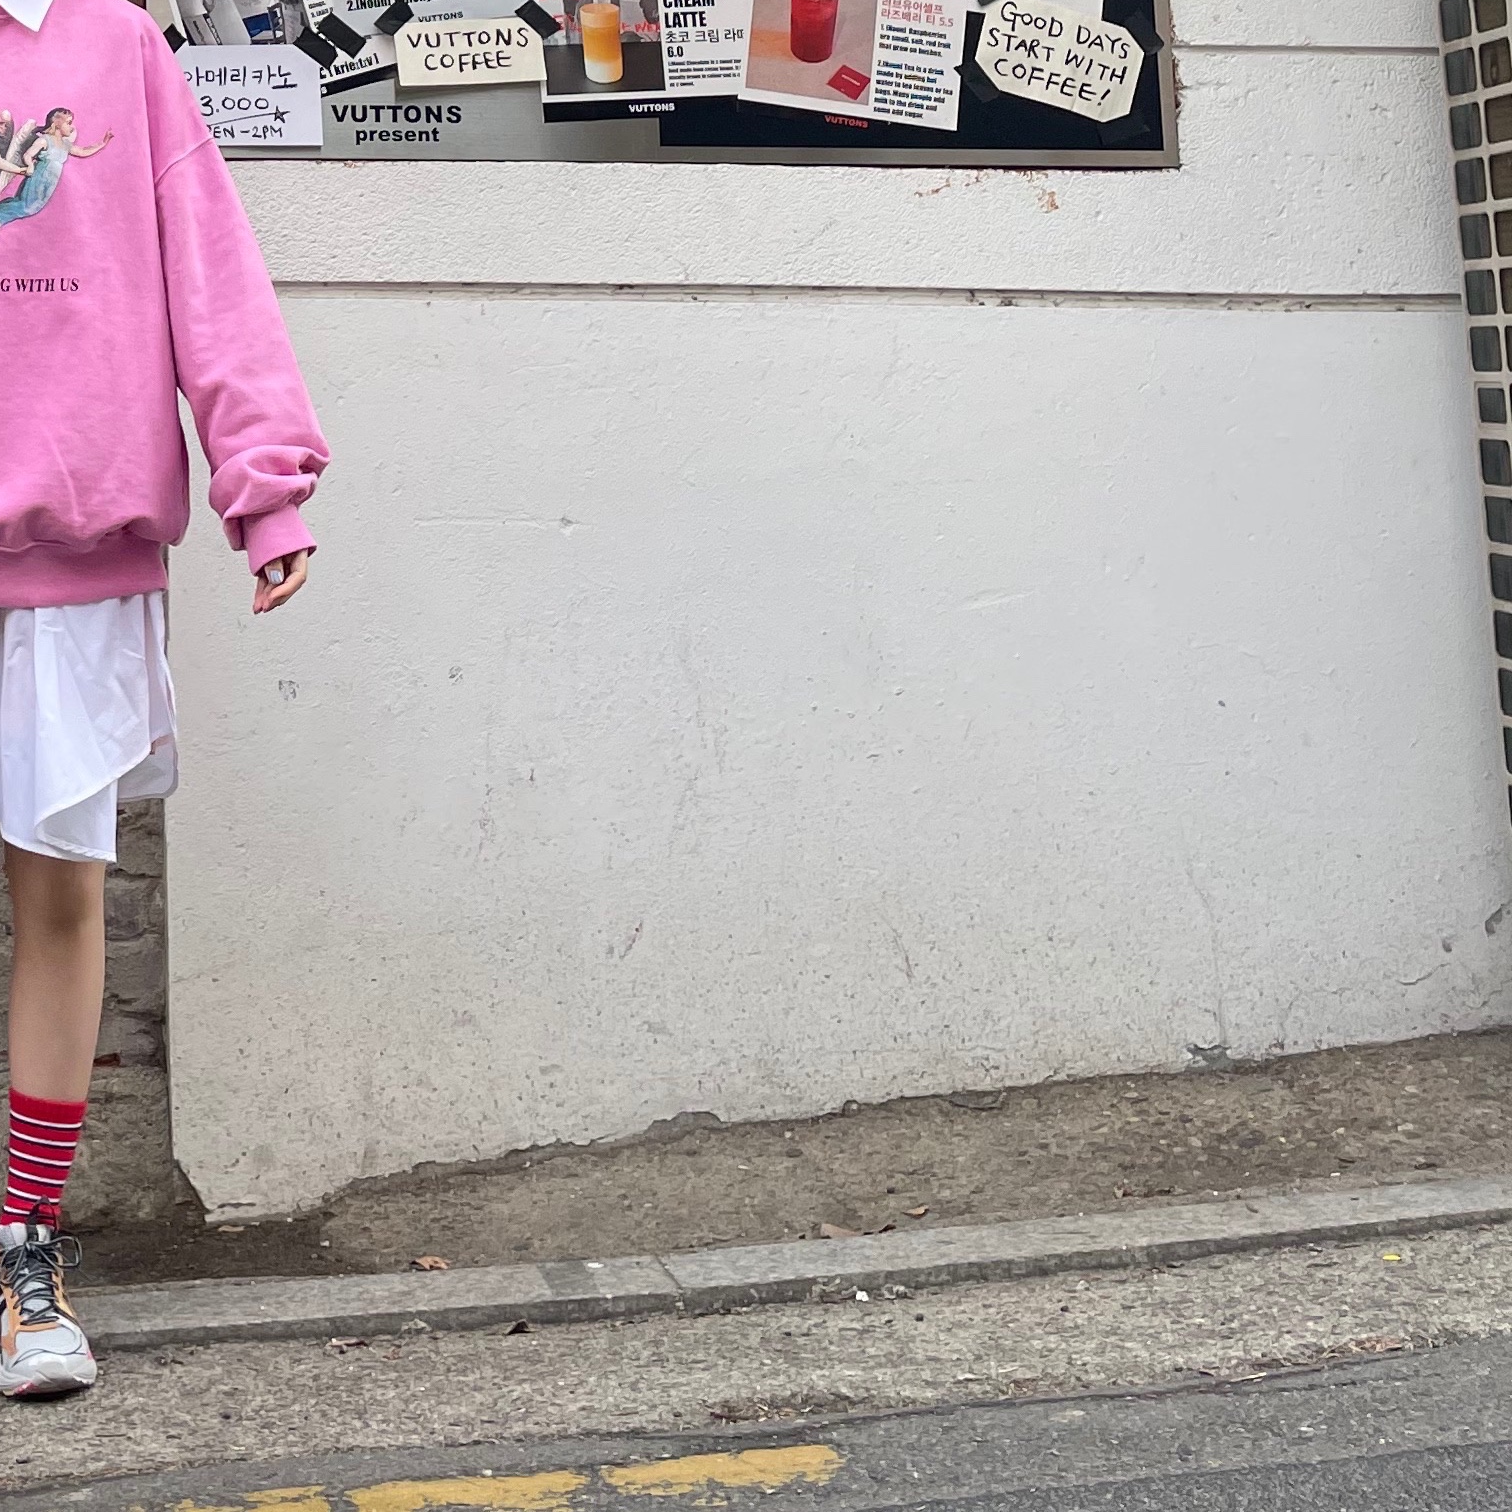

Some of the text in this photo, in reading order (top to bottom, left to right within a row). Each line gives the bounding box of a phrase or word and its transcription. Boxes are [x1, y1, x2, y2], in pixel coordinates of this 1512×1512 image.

[418, 12, 463, 22] VUTTONS
[664, 11, 707, 28] LATTE
[407, 27, 529, 48] VUTTONS
[665, 29, 719, 43] 초코 크림
[1001, 1, 1130, 59] GOOD DAYS
[667, 46, 683, 58] 6.0
[988, 28, 1055, 62] START
[1065, 49, 1127, 85] WITH
[425, 50, 512, 73] COFFEE
[184, 65, 297, 89] 아메리카노
[994, 58, 1111, 106] COFFEE!
[331, 105, 462, 124] VUTTONS
[629, 103, 675, 112] VUTTONS
[355, 128, 439, 145] present
[15, 278, 55, 292] WITH
[61, 278, 79, 291] US
